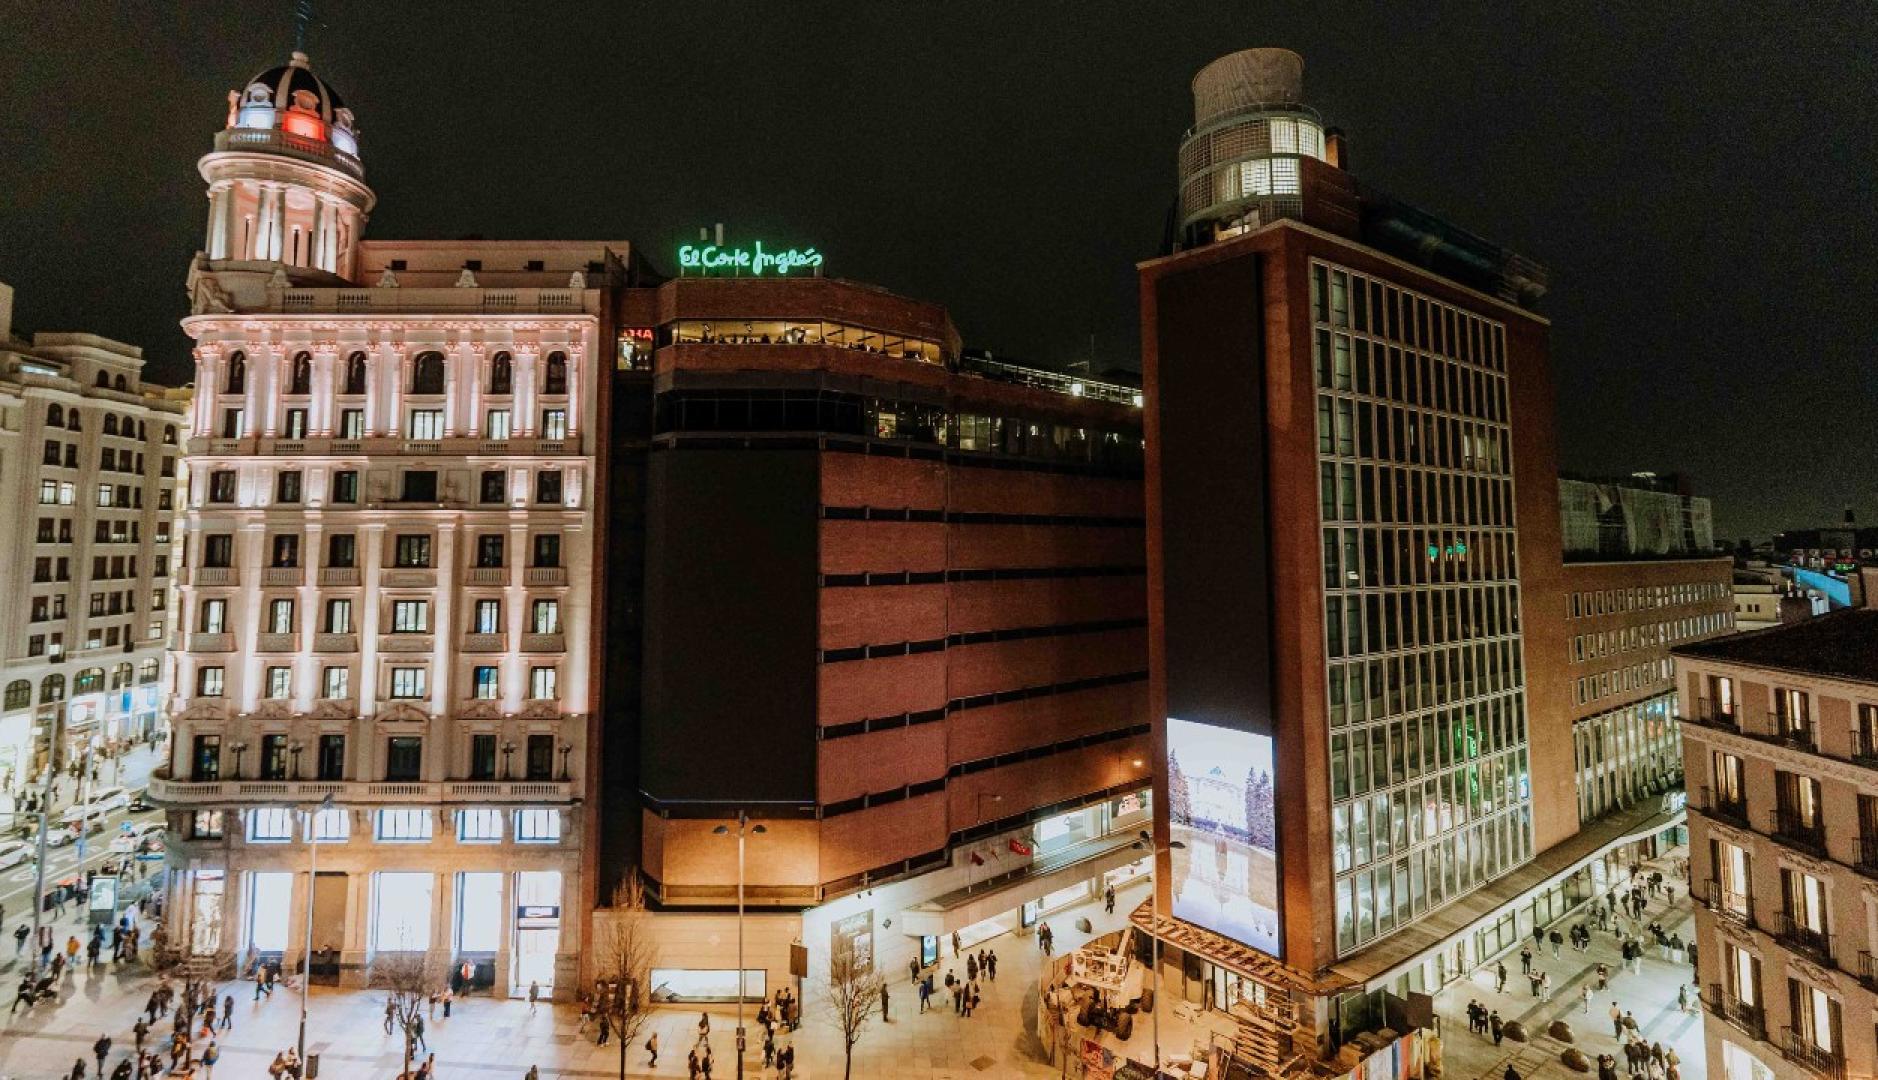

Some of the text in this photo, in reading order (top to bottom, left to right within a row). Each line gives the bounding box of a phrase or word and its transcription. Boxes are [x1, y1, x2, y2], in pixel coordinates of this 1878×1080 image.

[679, 241, 822, 275] El Corte Inglés
